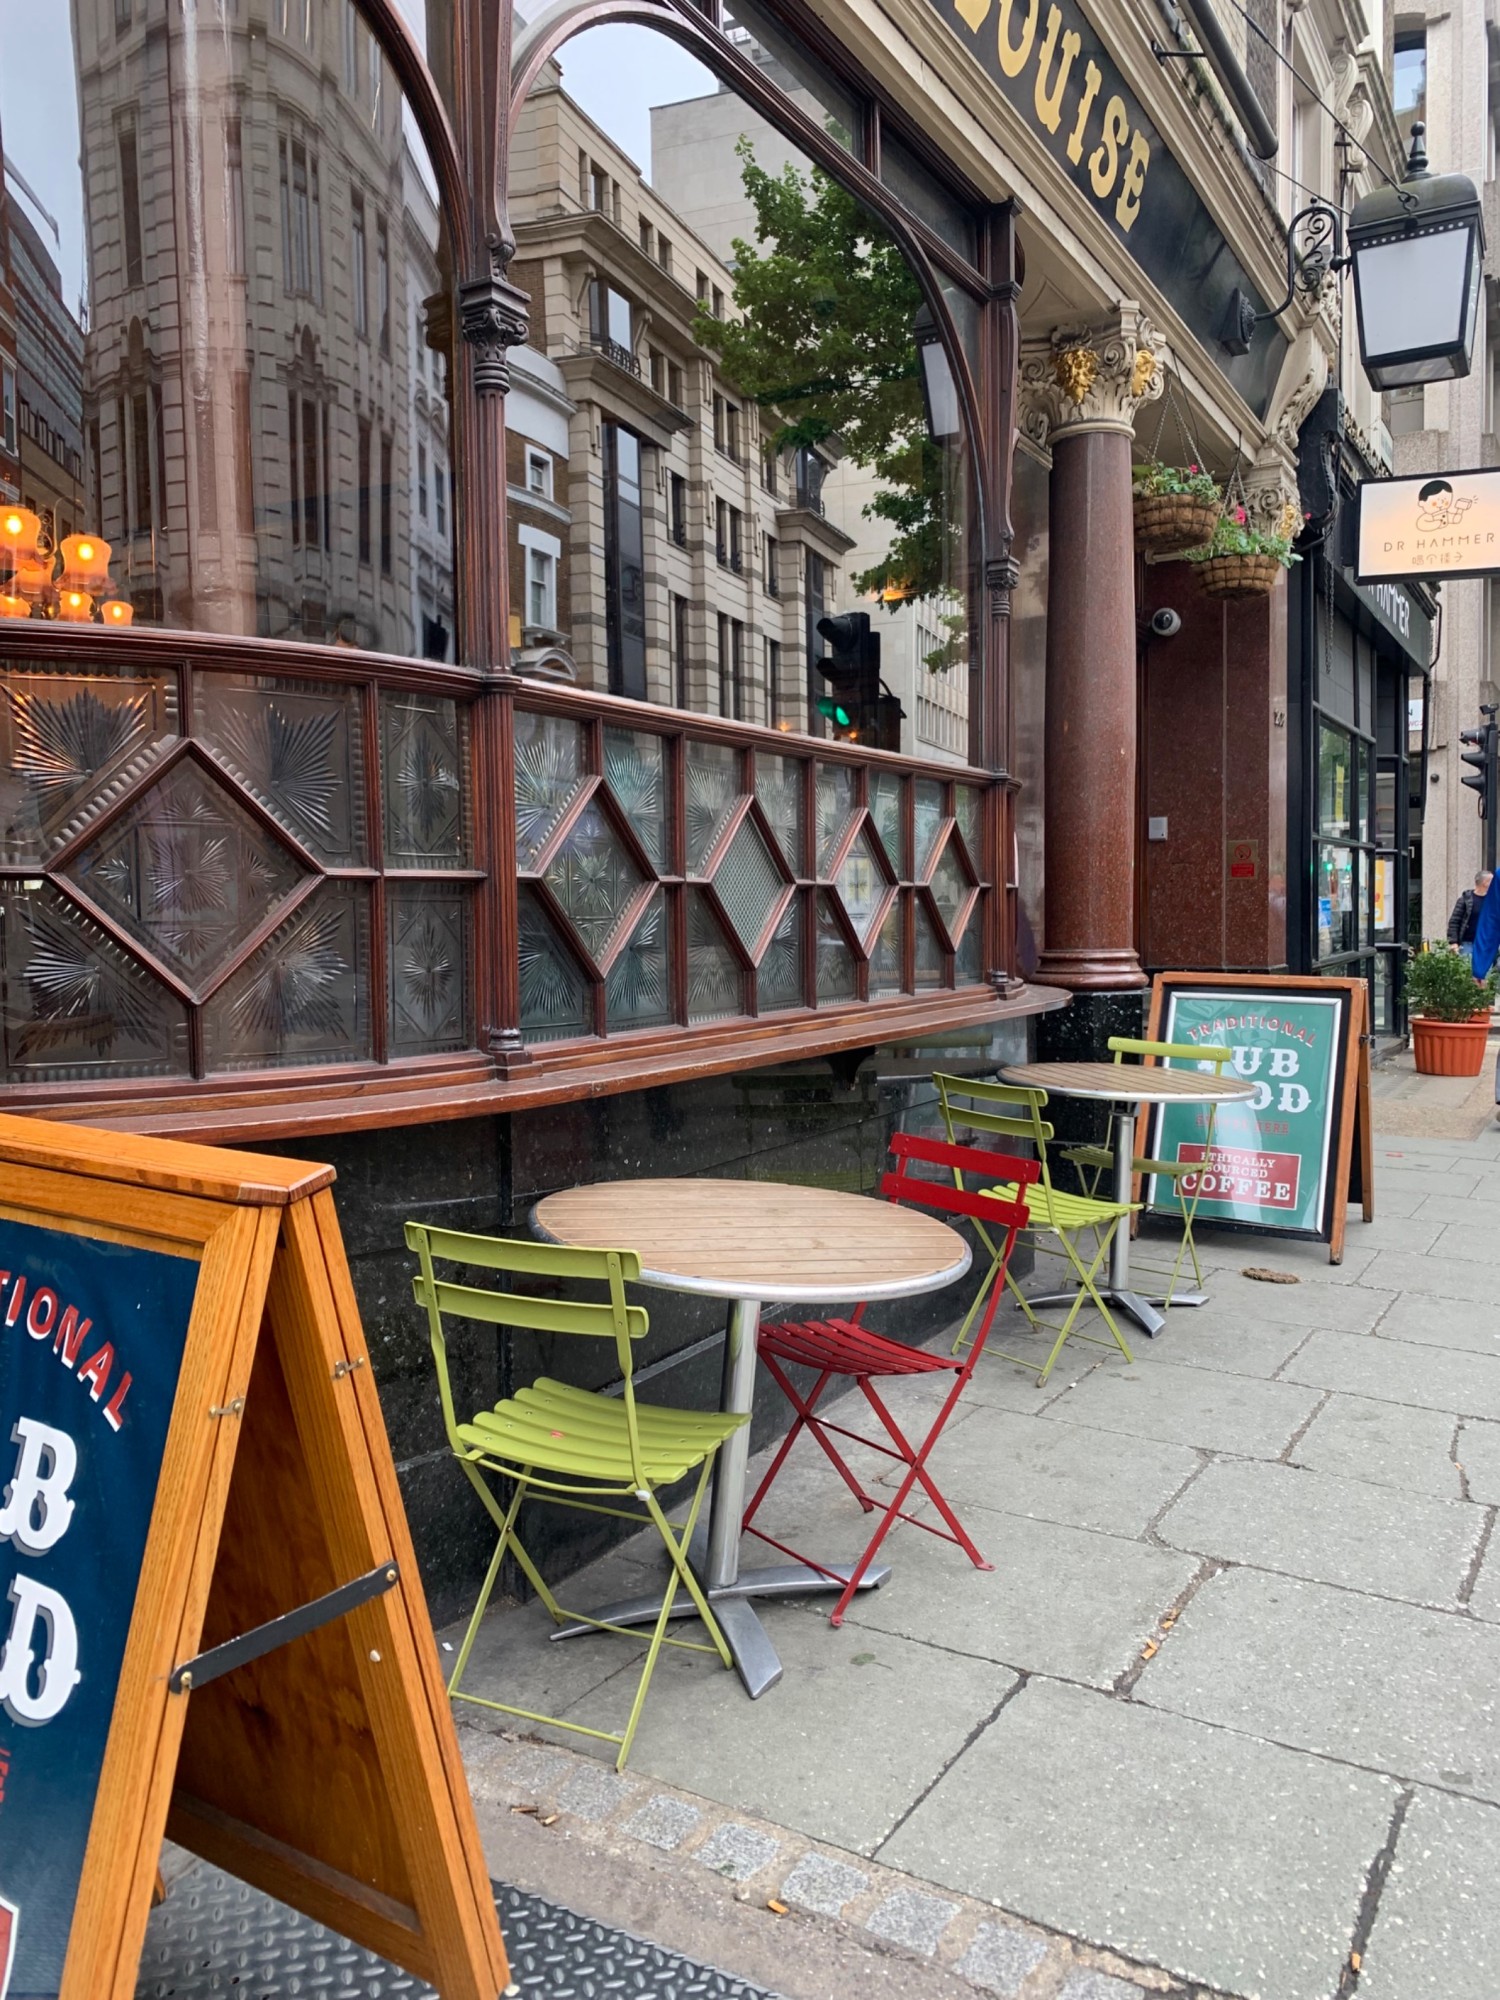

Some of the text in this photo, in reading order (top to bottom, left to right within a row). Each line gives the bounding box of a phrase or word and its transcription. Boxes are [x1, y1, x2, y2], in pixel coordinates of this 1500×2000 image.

[1383, 532, 1496, 552] DR HAMMER
[1186, 1016, 1317, 1048] TRADITIONAL
[1197, 1043, 1300, 1078] UB
[1205, 1163, 1269, 1179] SOURCED
[1181, 1174, 1291, 1201] COFFEE
